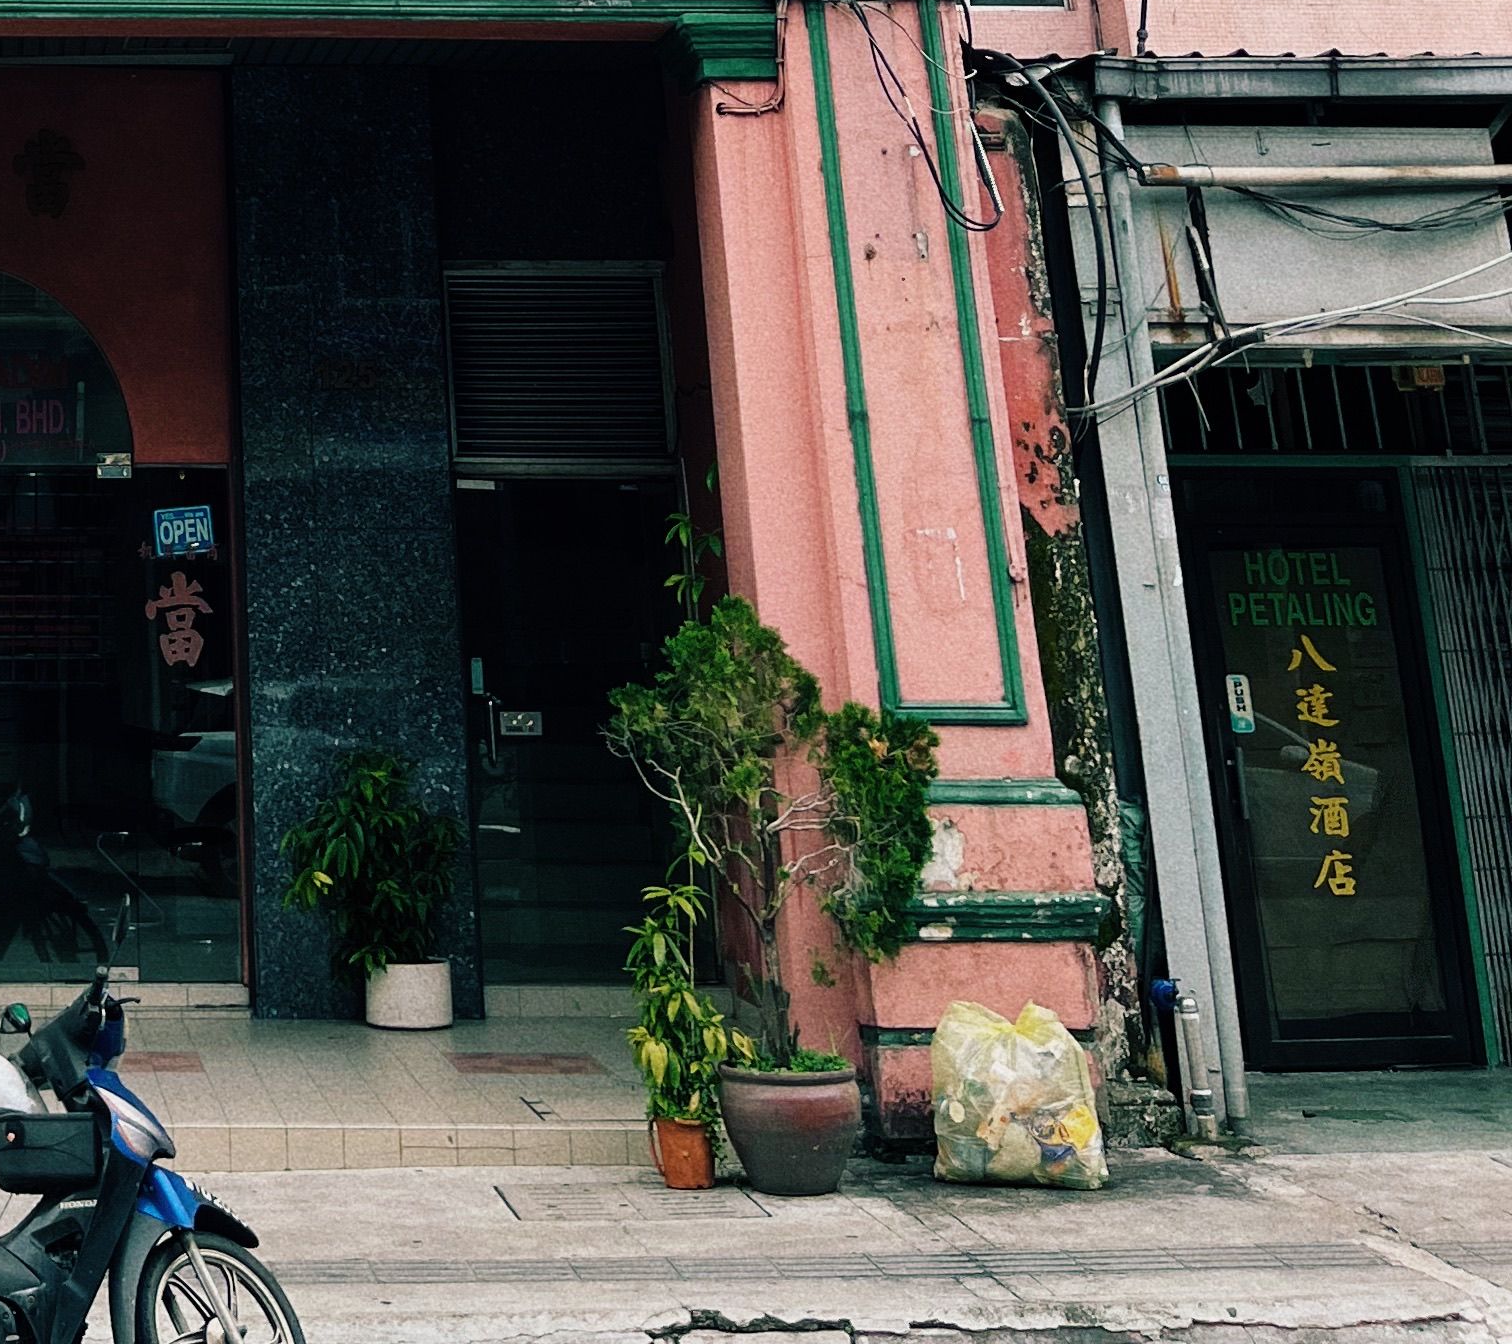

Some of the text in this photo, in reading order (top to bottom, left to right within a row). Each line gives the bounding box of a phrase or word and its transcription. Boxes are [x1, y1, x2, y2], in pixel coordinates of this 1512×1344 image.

[16, 400, 71, 434] BHD.
[160, 517, 209, 545] OPEN
[1243, 549, 1351, 586] HOTEL
[1228, 591, 1378, 627] PETALING
[1287, 634, 1357, 897] 八達嶺酒店
